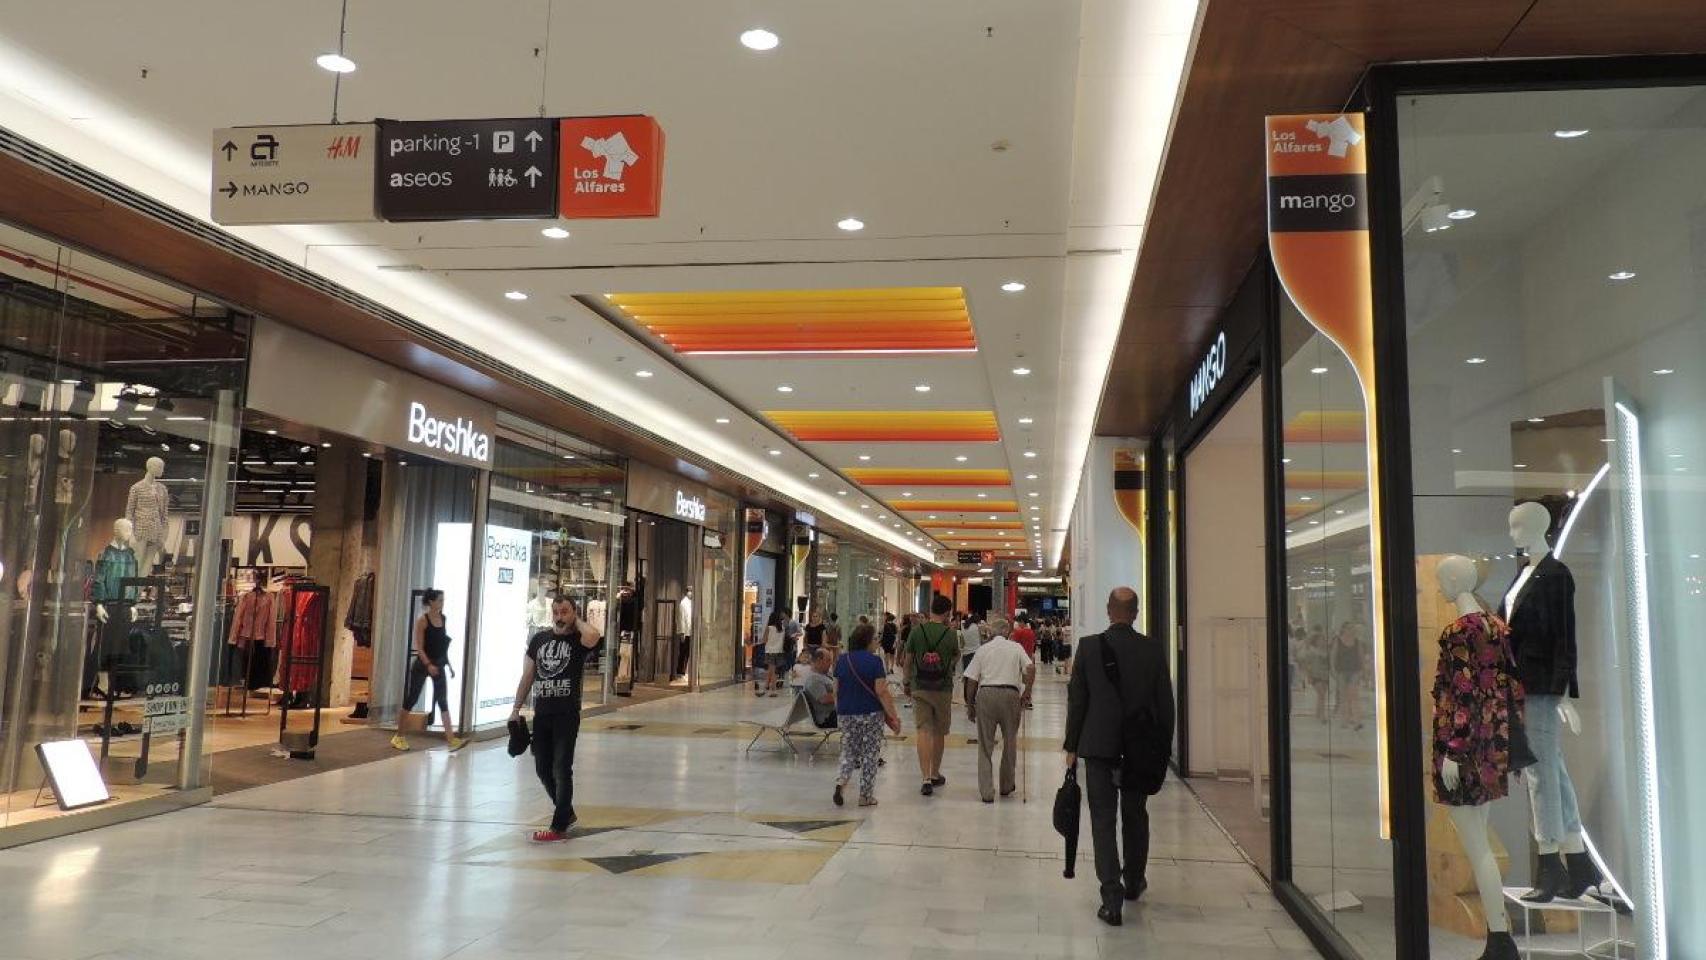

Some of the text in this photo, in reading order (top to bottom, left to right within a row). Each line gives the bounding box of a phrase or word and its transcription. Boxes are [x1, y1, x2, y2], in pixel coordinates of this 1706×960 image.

[1272, 130, 1296, 141] Los
[390, 133, 462, 157] parking
[465, 133, 480, 150] -1
[1273, 141, 1322, 153] Alfares
[390, 171, 453, 187] aseos
[573, 167, 599, 179] Los
[242, 181, 310, 197] MANGO
[574, 181, 626, 193] Alfares
[1280, 194, 1356, 213] mango
[1190, 331, 1226, 419] MANGO
[408, 402, 488, 462] Bershka
[676, 490, 706, 521] Bershka
[488, 535, 527, 562] Bershka
